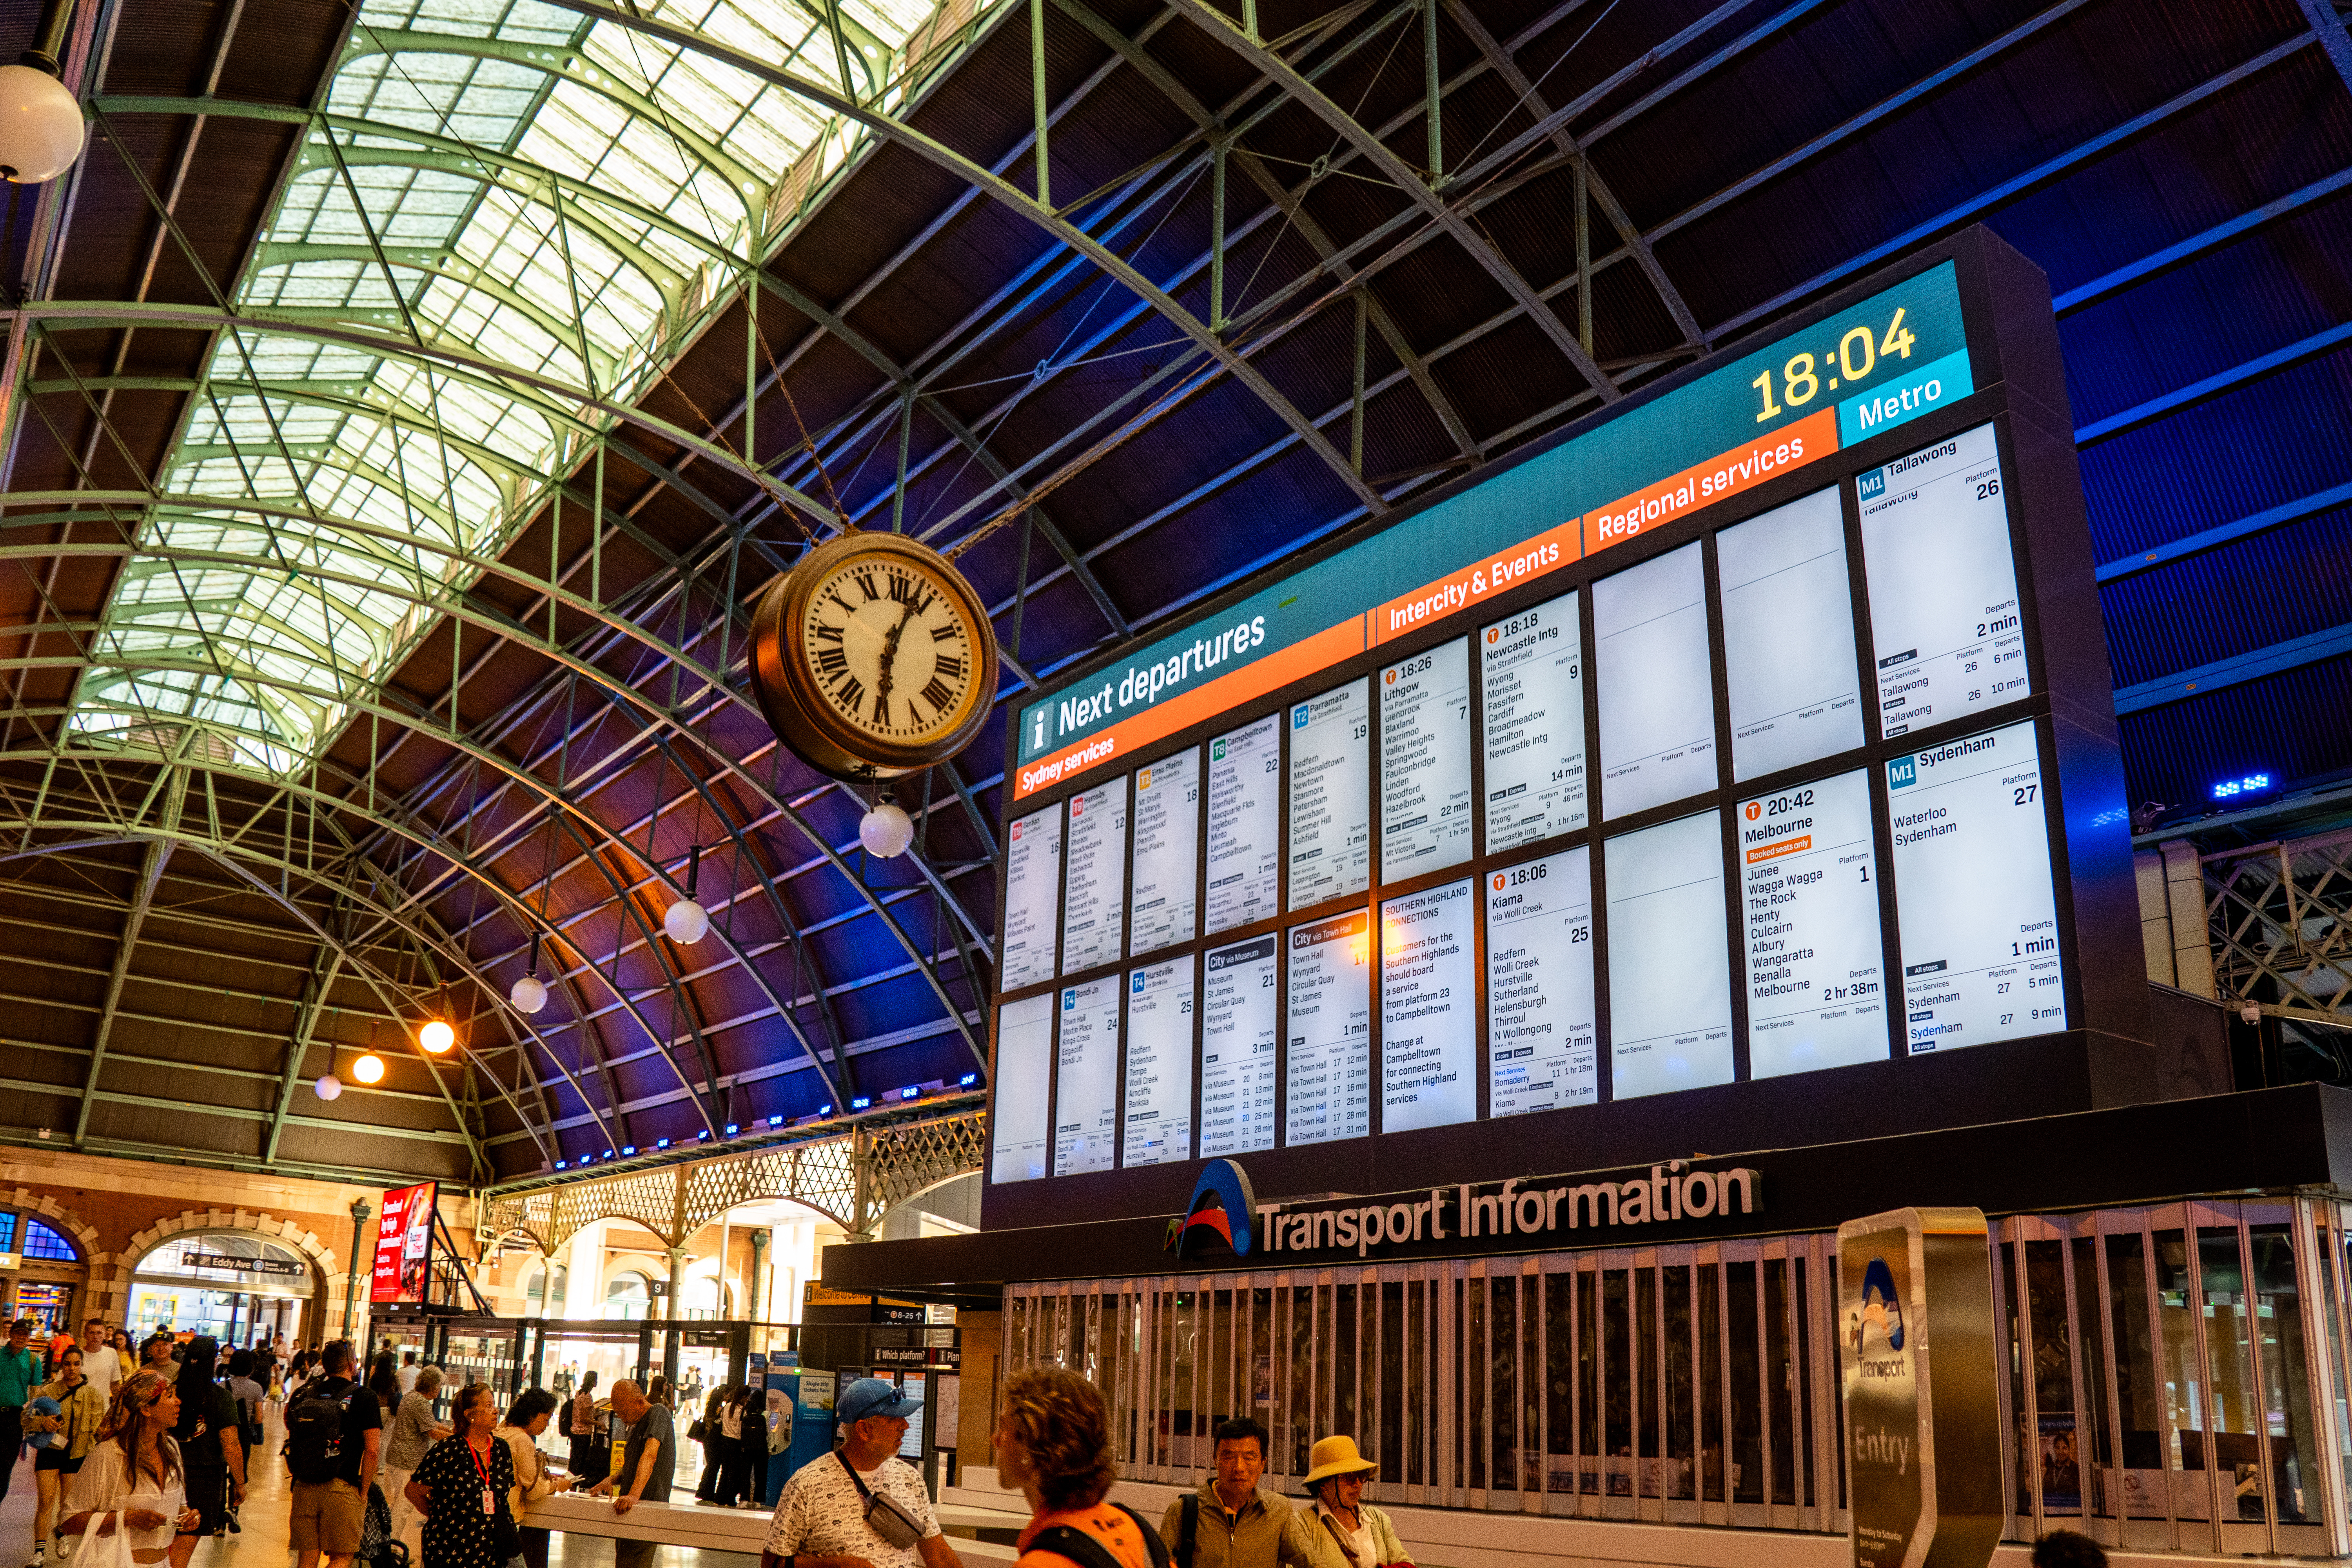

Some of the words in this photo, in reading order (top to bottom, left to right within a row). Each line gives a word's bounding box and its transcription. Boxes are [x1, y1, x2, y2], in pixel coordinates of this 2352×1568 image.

[1752, 308, 1915, 423] 18:04
[1858, 379, 1941, 430] Metro
[1862, 475, 1882, 494] M1
[1887, 442, 1956, 476] Tallawong
[1965, 468, 1997, 484] Platform
[1599, 478, 1694, 541] Regional
[1702, 437, 1803, 498] services
[1976, 479, 1999, 501] 26
[1390, 581, 1468, 631] Intercity
[1472, 571, 1487, 594] &
[1492, 543, 1559, 586] Events
[1985, 600, 2015, 614] Departs
[1504, 613, 1537, 637] 18:18
[1977, 623, 1986, 637] 2
[1990, 615, 2017, 633] min
[1486, 635, 1536, 661] Newcastle
[1539, 626, 1557, 641] Intg
[1401, 656, 1431, 679] 18:26
[1555, 654, 1577, 666] Platform
[1059, 683, 1113, 736] Next
[1119, 615, 1265, 707] departures
[1487, 672, 1513, 687] Wyong
[1570, 665, 1577, 679] 9
[1882, 677, 1928, 697] Tallawong
[1965, 661, 1977, 673] 26
[1994, 654, 2000, 663] 6
[2003, 648, 2021, 661] min
[1385, 681, 1419, 701] Lithgow
[1488, 680, 1521, 699] Morisset
[1296, 711, 1307, 723] T2
[1310, 692, 1349, 713] Parramatta
[1488, 693, 1523, 711] Fassifern
[1459, 706, 1466, 719] 7
[1488, 706, 1514, 723] Cardiff
[1489, 709, 1544, 735] Broadmeadow
[1354, 724, 1366, 740] 19
[1385, 715, 1414, 734] Blaxland
[1215, 744, 1224, 756] T8
[1227, 723, 1272, 746] Campbelltown
[1385, 728, 1418, 744] Warrimoo
[1386, 744, 1405, 756] Valley
[1408, 733, 1434, 748] Heights
[1489, 730, 1523, 747] Hamilton
[1023, 757, 1063, 791] Sydney
[1065, 738, 1114, 772] services
[1265, 759, 1277, 773] 22
[1386, 745, 1426, 768] Springwood
[1892, 764, 1913, 782] M1
[1920, 737, 1994, 767] Sydenham
[1294, 756, 1344, 779] Macdonaldtown
[1386, 757, 1435, 779] Faulconbridge
[1294, 775, 1323, 790] Newtown
[1386, 777, 1408, 791] Linden
[2002, 772, 2036, 785] Platform
[1187, 789, 1196, 802] 18
[1294, 786, 1323, 802] Stanmore
[1386, 783, 1419, 802] Woodford
[1510, 786, 1524, 795] Express
[2014, 784, 2036, 806] 27
[1294, 796, 1327, 812] Petersham
[1386, 794, 1425, 814] Hazelbrook
[1768, 789, 1814, 816] 20:42
[1115, 817, 1123, 829] 12
[1294, 808, 1325, 824] Lewisham
[1894, 808, 1946, 828] Waterloo
[1294, 830, 1318, 845] Ashfield
[1745, 817, 1812, 843] Melbourne
[1895, 823, 1956, 846] Sydenham
[1750, 847, 1773, 860] Booked
[1775, 844, 1793, 853] seats
[1794, 839, 1808, 848] only
[1839, 853, 1868, 864] Platform
[1511, 864, 1546, 886] 18:06
[1748, 866, 1779, 880] Junee
[1748, 880, 1783, 895] Wagga
[1786, 870, 1822, 886] Wagga
[1860, 866, 1869, 882] 1
[1386, 897, 1425, 915] SOUTHERN
[1428, 886, 1467, 904] HIGHLAND
[1492, 894, 1522, 909] Kiama
[1749, 897, 1767, 909] The
[1771, 889, 1796, 905] Rock
[1385, 907, 1439, 929] CONNECTIONS
[1750, 910, 1780, 924] Henty
[2021, 920, 2053, 932] Departs
[1295, 933, 1311, 945] City
[1323, 928, 1339, 938] Town
[1339, 922, 1352, 935] Hall
[1572, 926, 1588, 943] 25
[1751, 922, 1792, 939] Culcairn
[1494, 948, 1525, 962] Redfern
[1752, 939, 1784, 954] Albury
[2012, 942, 2021, 956] 1
[2025, 936, 2054, 953] min
[1210, 956, 1225, 967] City
[1235, 950, 1258, 961] Museum
[1494, 962, 1512, 975] Wolli
[1515, 956, 1539, 970] Creek
[1752, 948, 1813, 968] Wangaratta
[1134, 977, 1143, 987] T4
[1146, 966, 1173, 980] Hurstville
[1292, 963, 1320, 978] Wynyard
[1494, 971, 1532, 988] Hurstville
[1753, 967, 1790, 984] Benalla
[1262, 974, 1274, 987] 21
[1386, 1000, 1403, 1009] from
[1405, 992, 1437, 1007] platform
[1440, 988, 1449, 998] 23
[1494, 982, 1538, 1001] Sutherland
[1824, 989, 1831, 1000] 2
[1835, 986, 1847, 998] hr
[1851, 982, 1878, 995] 38m
[1181, 1000, 1191, 1013] 25
[1396, 1004, 1450, 1021] Campbelltown
[1495, 995, 1546, 1014] Helensburgh
[1107, 1018, 1116, 1030] 24
[1387, 1094, 1417, 1105] services
[1256, 1189, 1446, 1256] Transport
[1460, 1158, 1752, 1237] Information
[212, 1258, 234, 1269] Eddy
[236, 1260, 251, 1269] Ave
[654, 1283, 661, 1293] 9
[882, 1350, 898, 1360] Which
[899, 1350, 925, 1361] platform?
[947, 1352, 959, 1361] Plan
[1857, 1355, 1905, 1382] Transport
[1856, 1425, 1909, 1475] Entry
